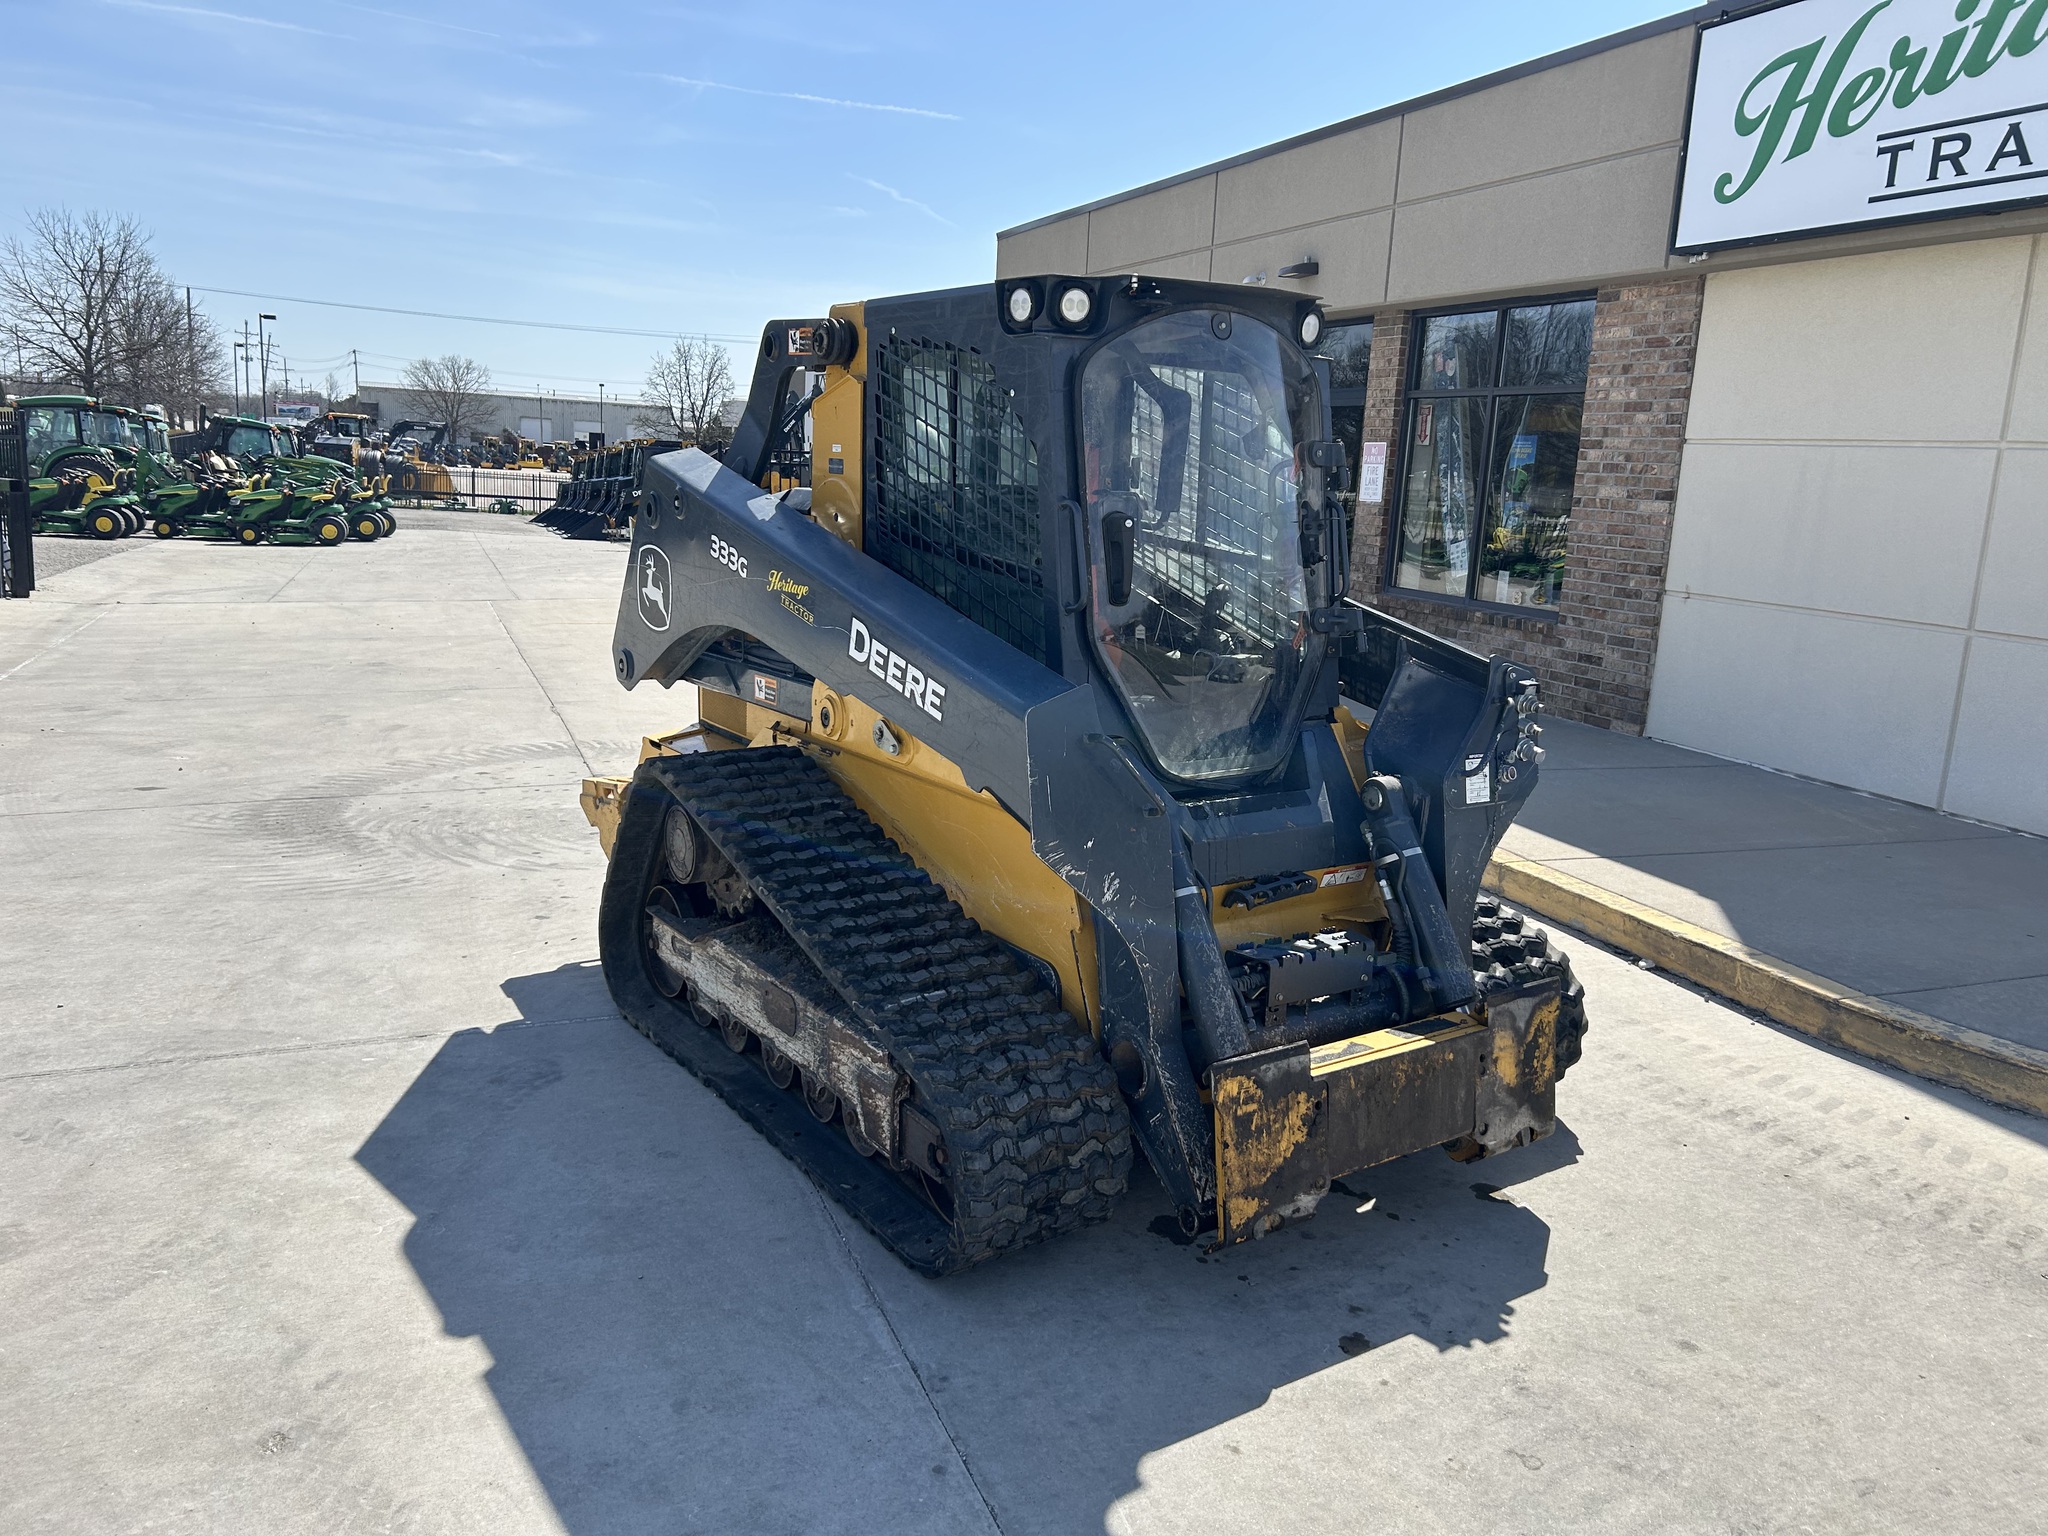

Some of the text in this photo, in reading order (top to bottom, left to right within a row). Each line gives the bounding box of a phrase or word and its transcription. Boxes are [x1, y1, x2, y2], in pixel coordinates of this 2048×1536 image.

[1371, 446, 1379, 455] NO
[1365, 477, 1379, 487] LANE
[1367, 466, 1379, 476] FIRE
[710, 534, 748, 578] 333G
[766, 569, 809, 599] Heritage
[781, 594, 815, 624] TRACTOR
[848, 617, 946, 722] DEERE
